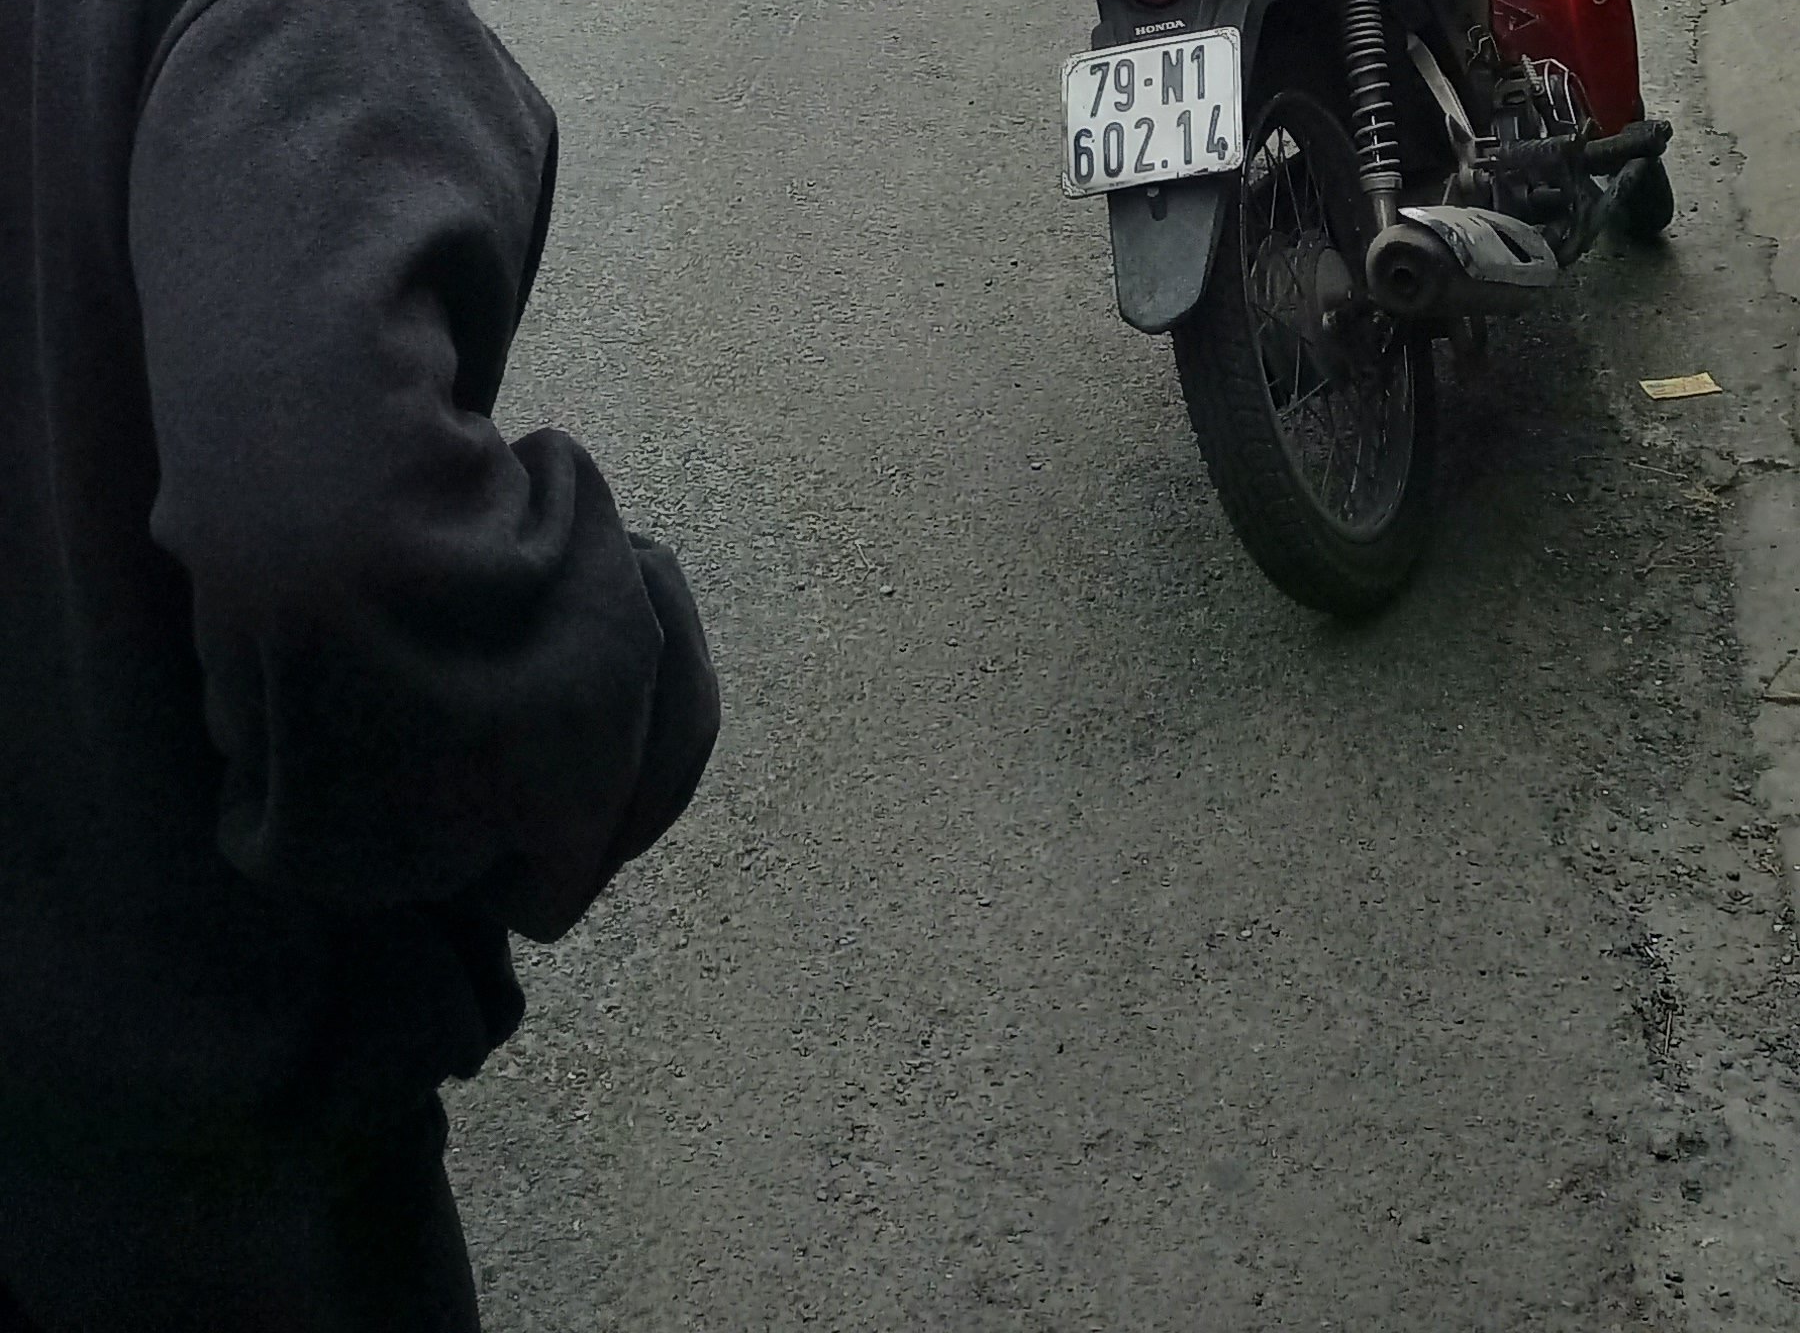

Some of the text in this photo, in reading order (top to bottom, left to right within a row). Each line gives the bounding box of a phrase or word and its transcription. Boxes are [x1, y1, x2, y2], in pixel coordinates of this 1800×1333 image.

[1135, 20, 1185, 36] HONDA
[1090, 45, 1206, 118] 79-N1
[1074, 105, 1229, 184] 602.14
